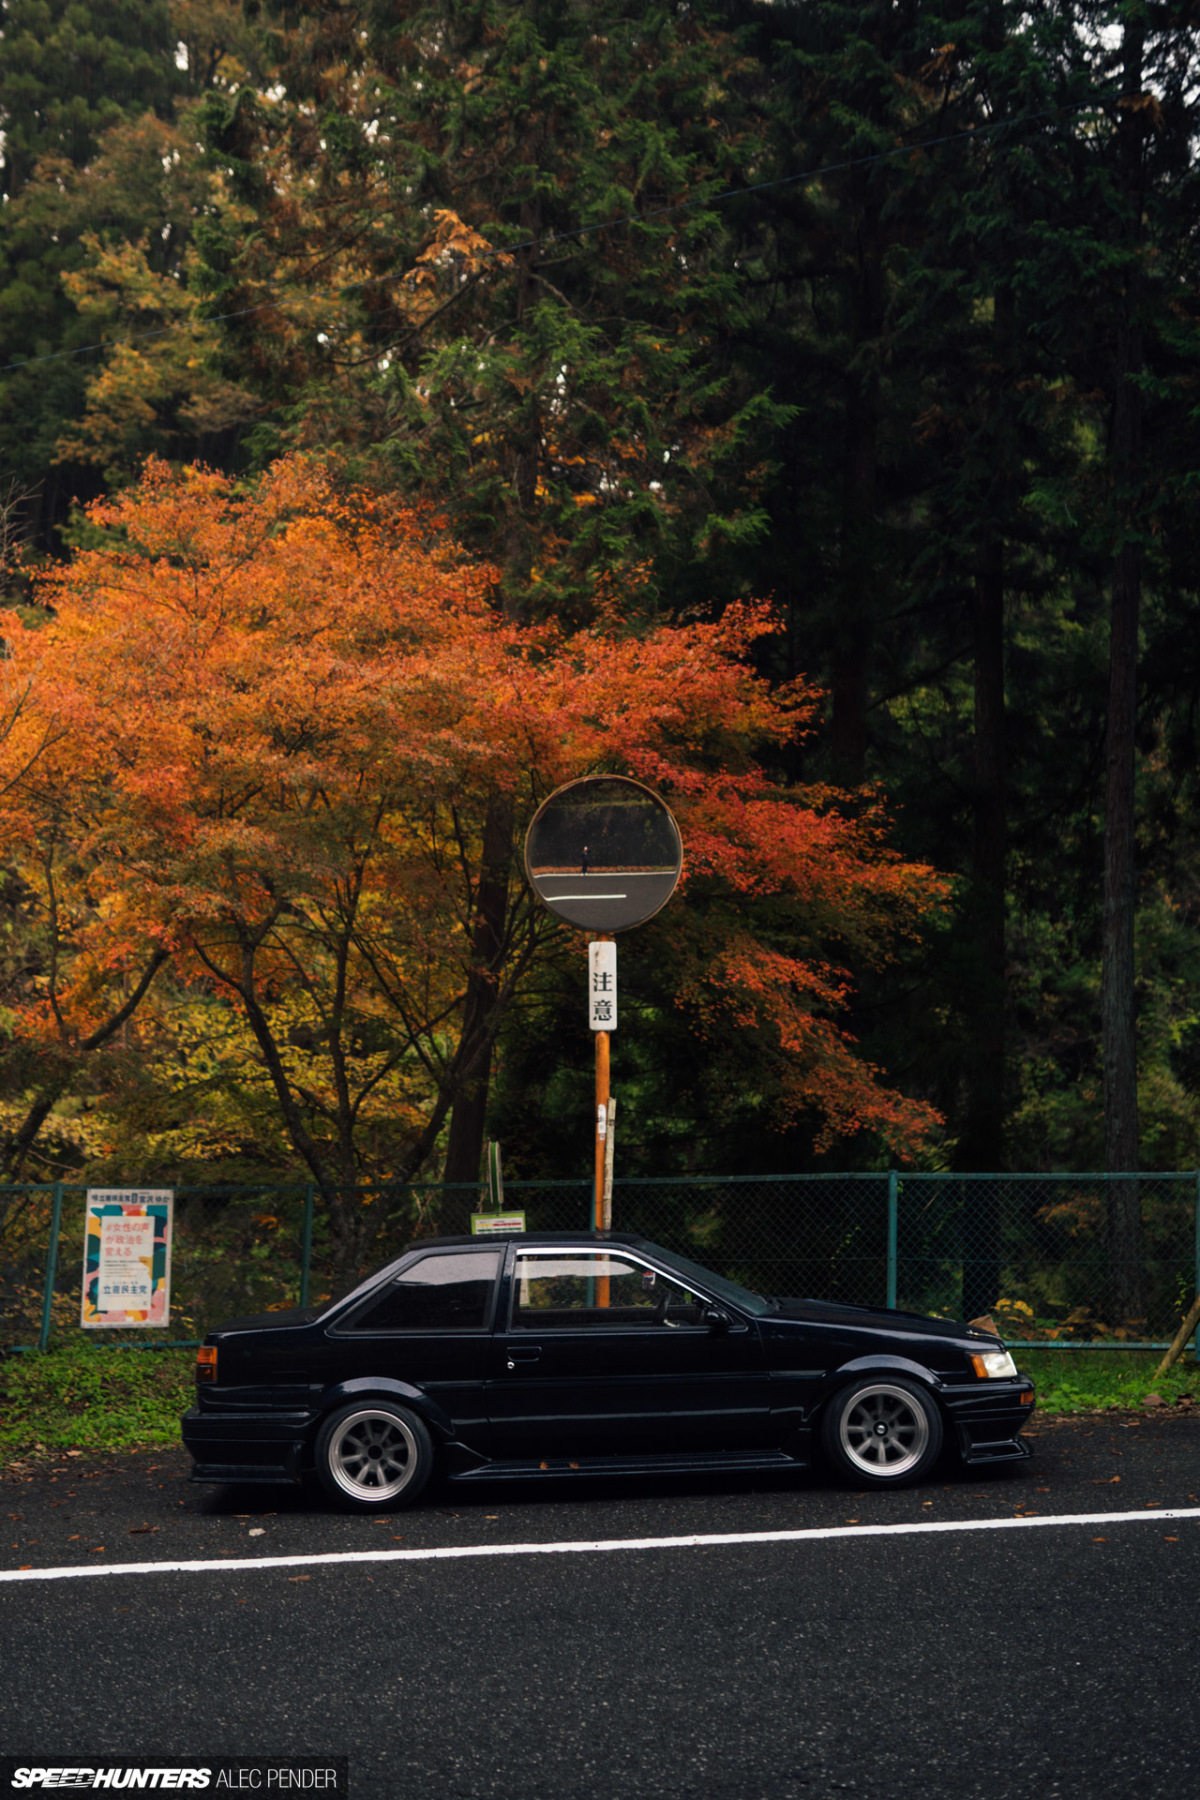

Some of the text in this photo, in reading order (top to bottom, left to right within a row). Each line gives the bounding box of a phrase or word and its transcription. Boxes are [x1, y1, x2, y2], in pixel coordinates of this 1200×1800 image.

[593, 971, 613, 1021] 注意
[103, 1285, 148, 1295] 立憲民主党
